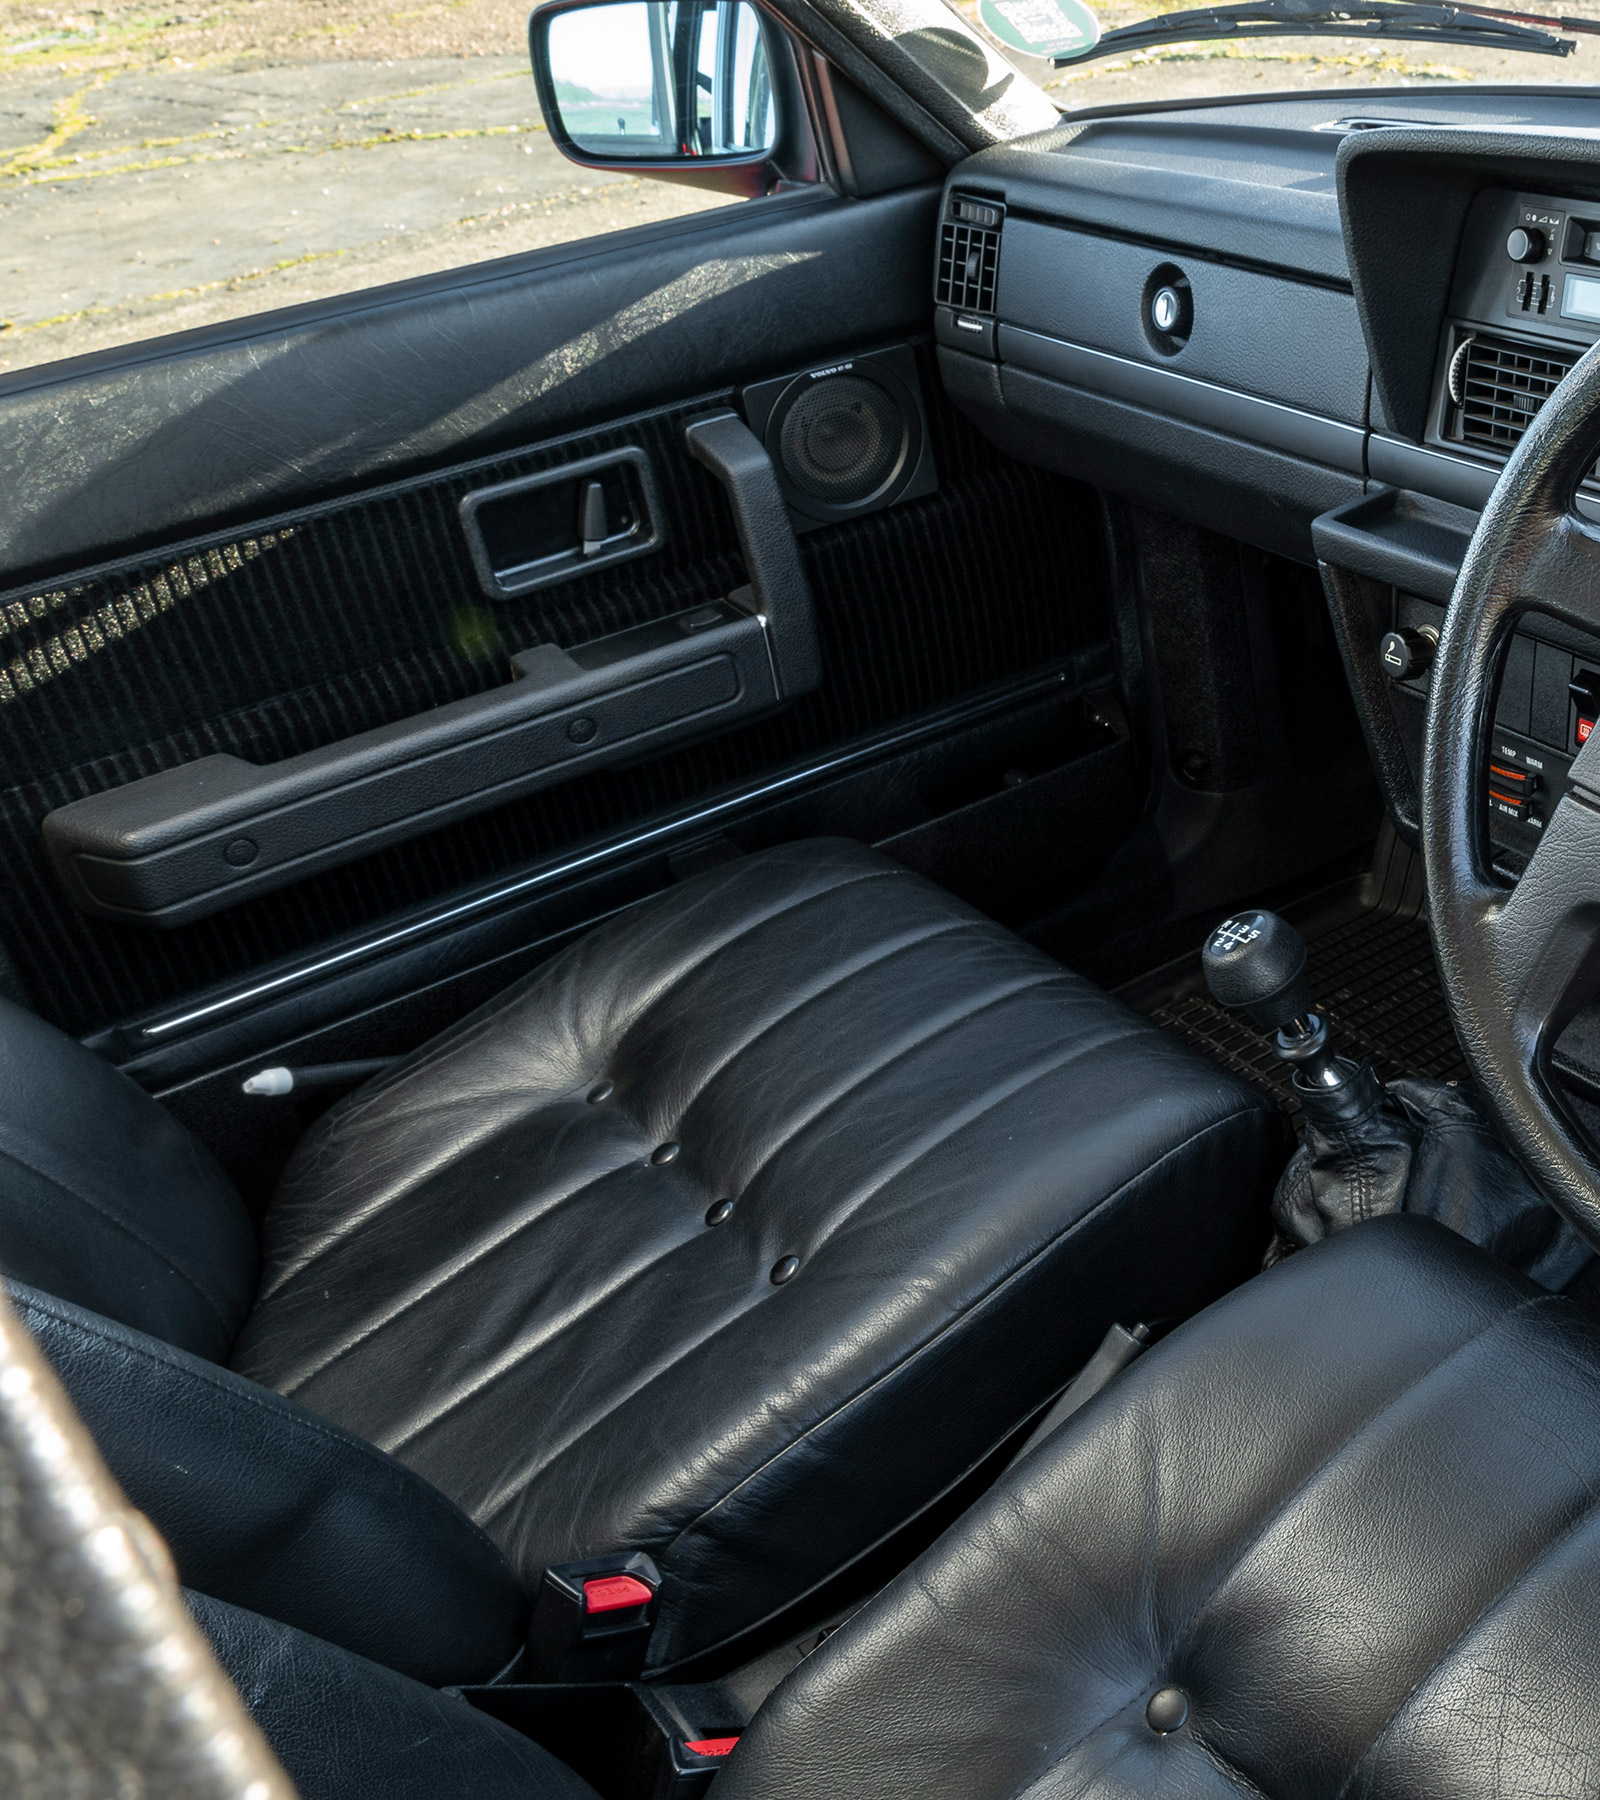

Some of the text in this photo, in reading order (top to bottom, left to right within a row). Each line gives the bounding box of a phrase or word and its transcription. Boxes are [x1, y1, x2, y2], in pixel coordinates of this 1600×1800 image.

[810, 367, 837, 379] VOLVO
[1501, 745, 1517, 758] TEMP
[1525, 756, 1543, 769] WARM
[1498, 803, 1508, 814] AIR
[1508, 807, 1519, 818] MIX
[1526, 817, 1543, 829] ARM
[1239, 925, 1250, 934] 3
[1248, 930, 1262, 939] 5
[1214, 938, 1225, 947] 2
[1223, 942, 1235, 950] 4
